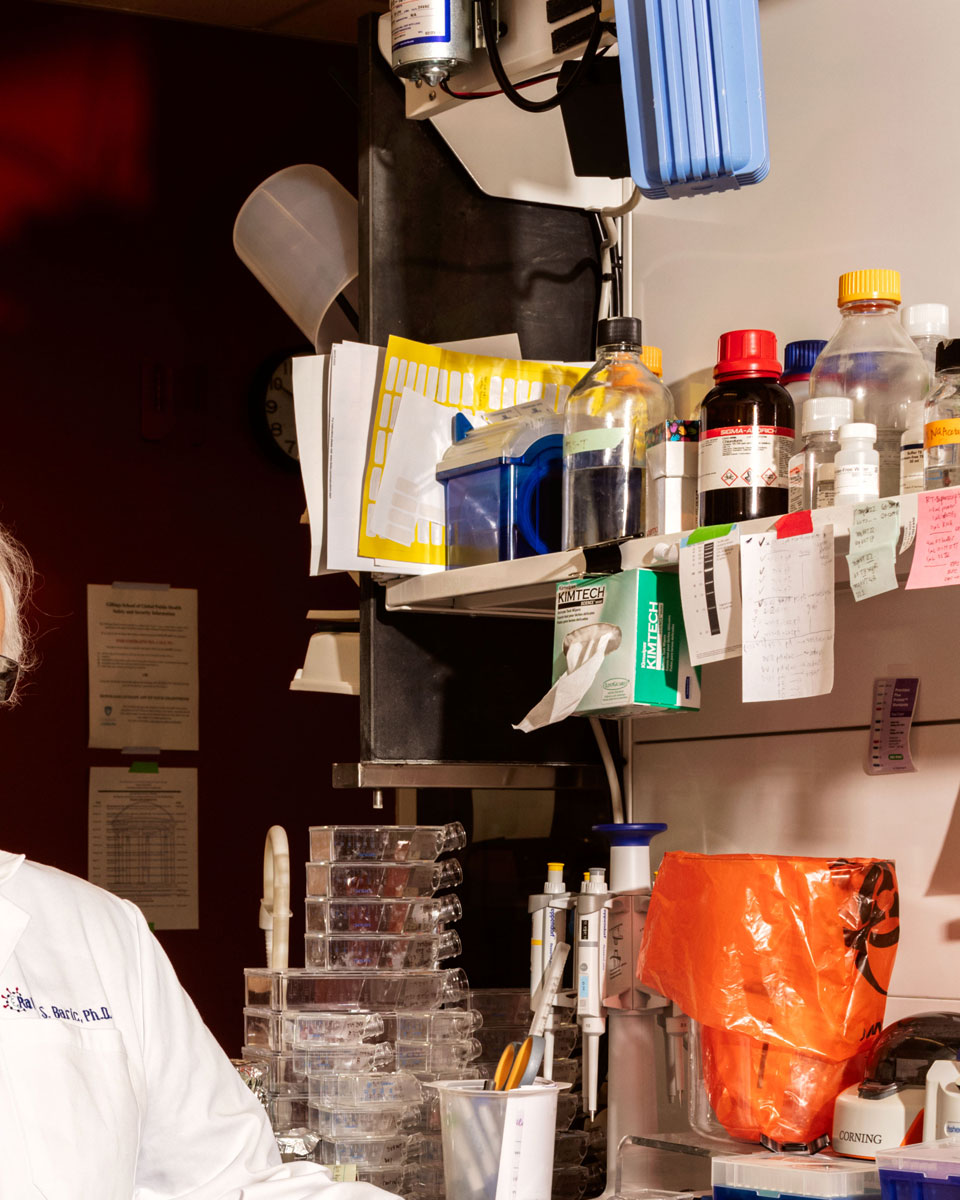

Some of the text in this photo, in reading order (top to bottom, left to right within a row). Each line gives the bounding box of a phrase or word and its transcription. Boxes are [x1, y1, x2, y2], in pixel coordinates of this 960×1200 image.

[266, 400, 278, 414] 9
[271, 422, 282, 437] 8
[720, 427, 777, 436] SIGMA-ADRICH
[284, 440, 296, 454] 7
[558, 586, 605, 603] KIMTECH
[646, 601, 658, 670] KIMTECH
[39, 1006, 51, 1019] S.
[51, 1006, 83, 1023] Baric,
[83, 1006, 113, 1022] Ph.D.
[840, 1130, 882, 1145] CORNING
